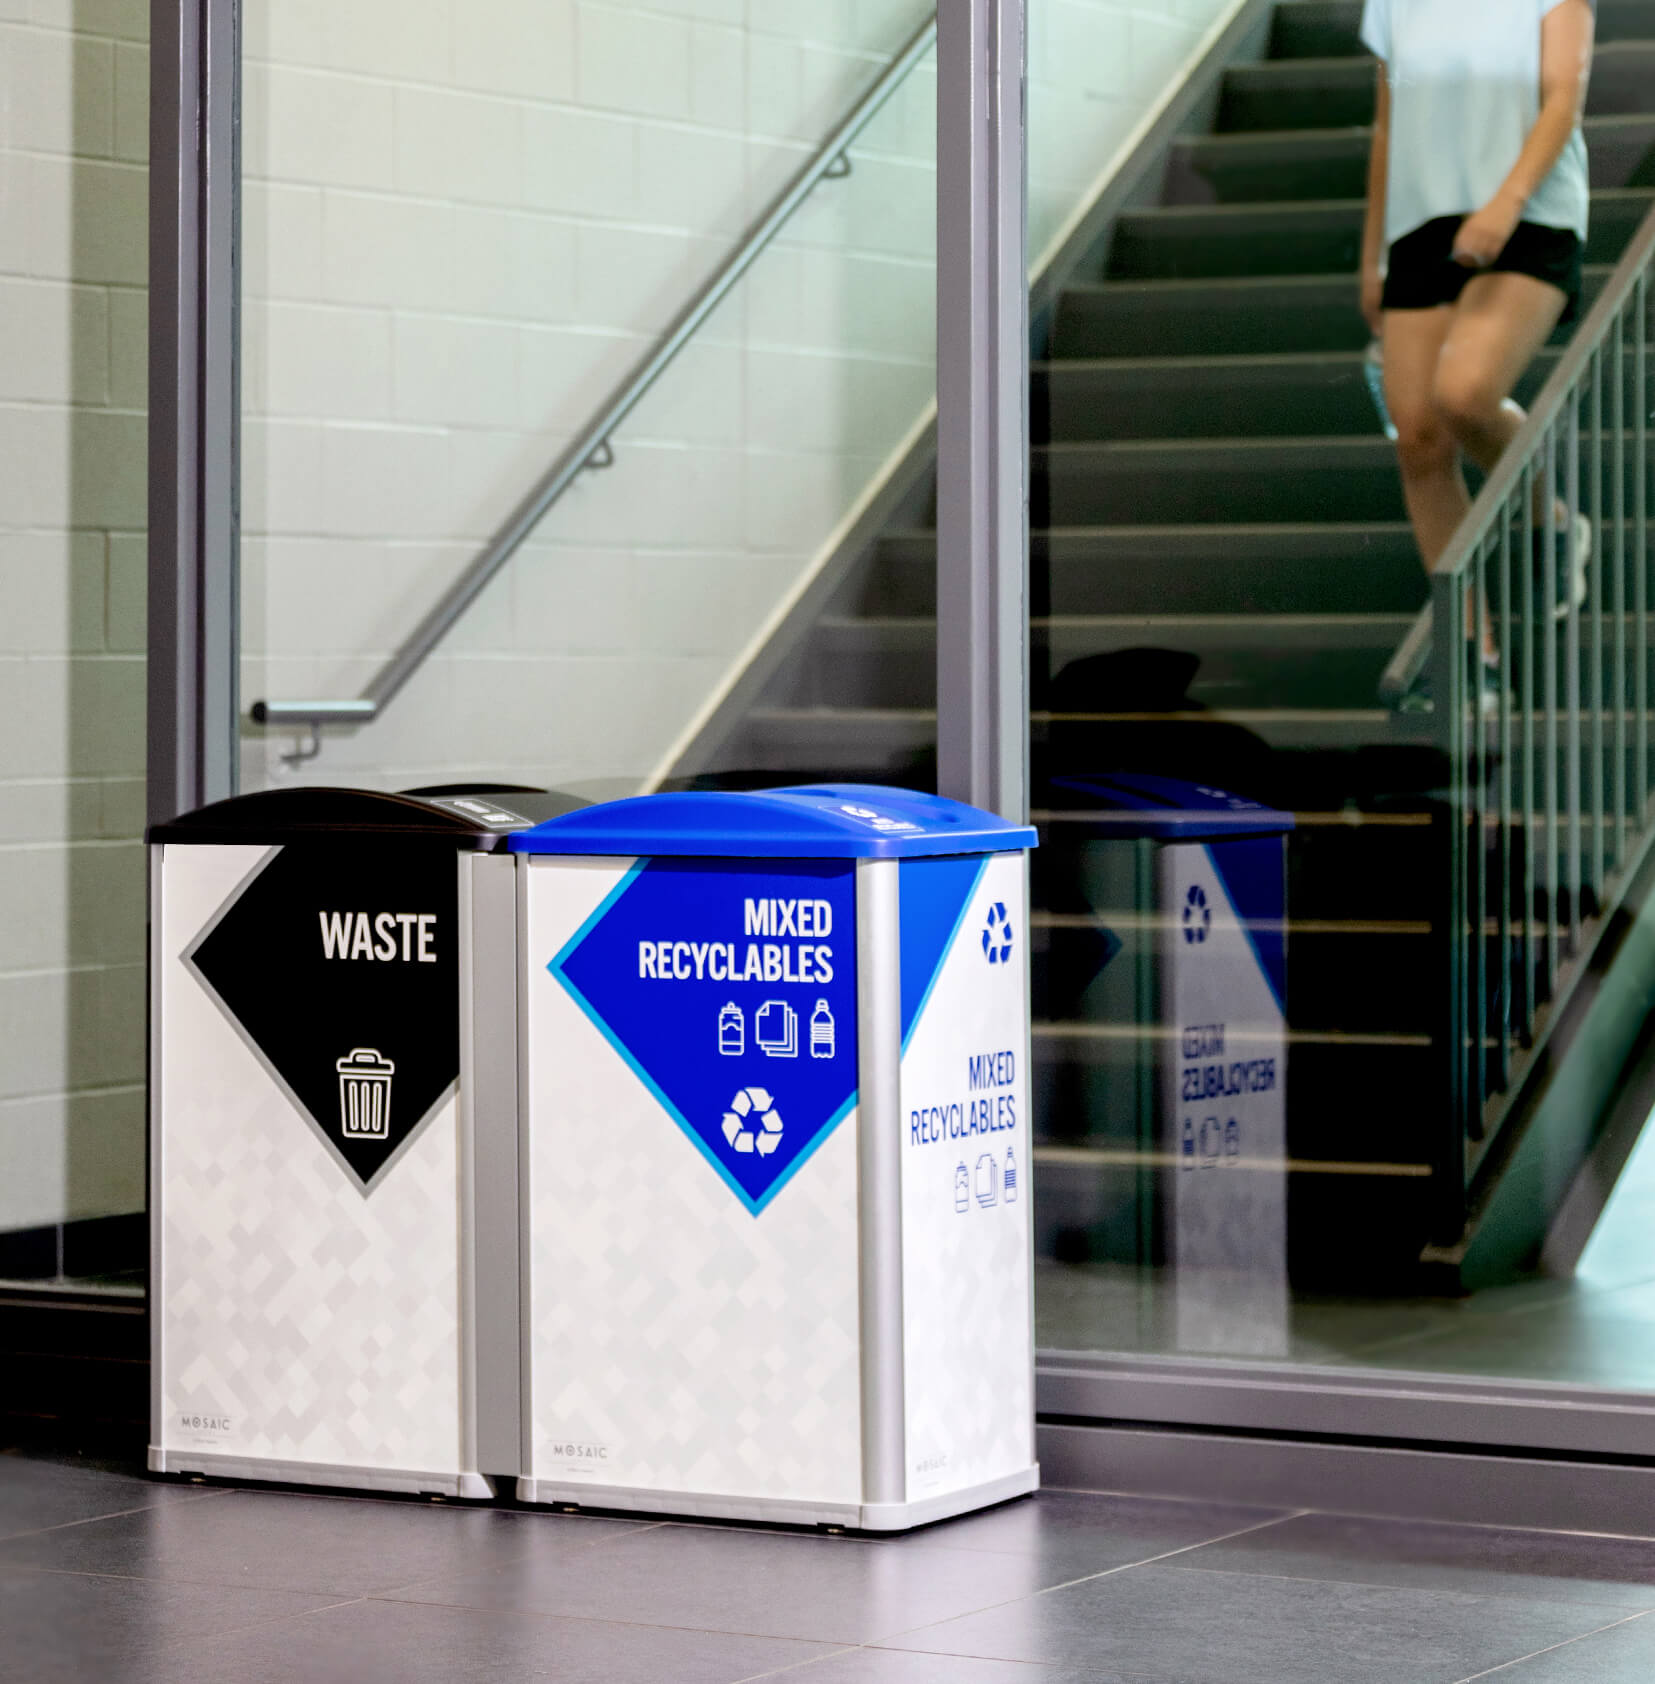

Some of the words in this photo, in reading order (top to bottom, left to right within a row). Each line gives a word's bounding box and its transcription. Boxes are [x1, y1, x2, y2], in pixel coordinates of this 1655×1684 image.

[319, 911, 437, 963] WASTE
[744, 898, 833, 938] MIXED
[638, 941, 834, 984] RECYCLABLES
[968, 1050, 1015, 1091] MIXED
[911, 1094, 1016, 1146] RECYCLABLES
[181, 1416, 231, 1431] MOSAIC
[553, 1444, 608, 1459] MOSAIC
